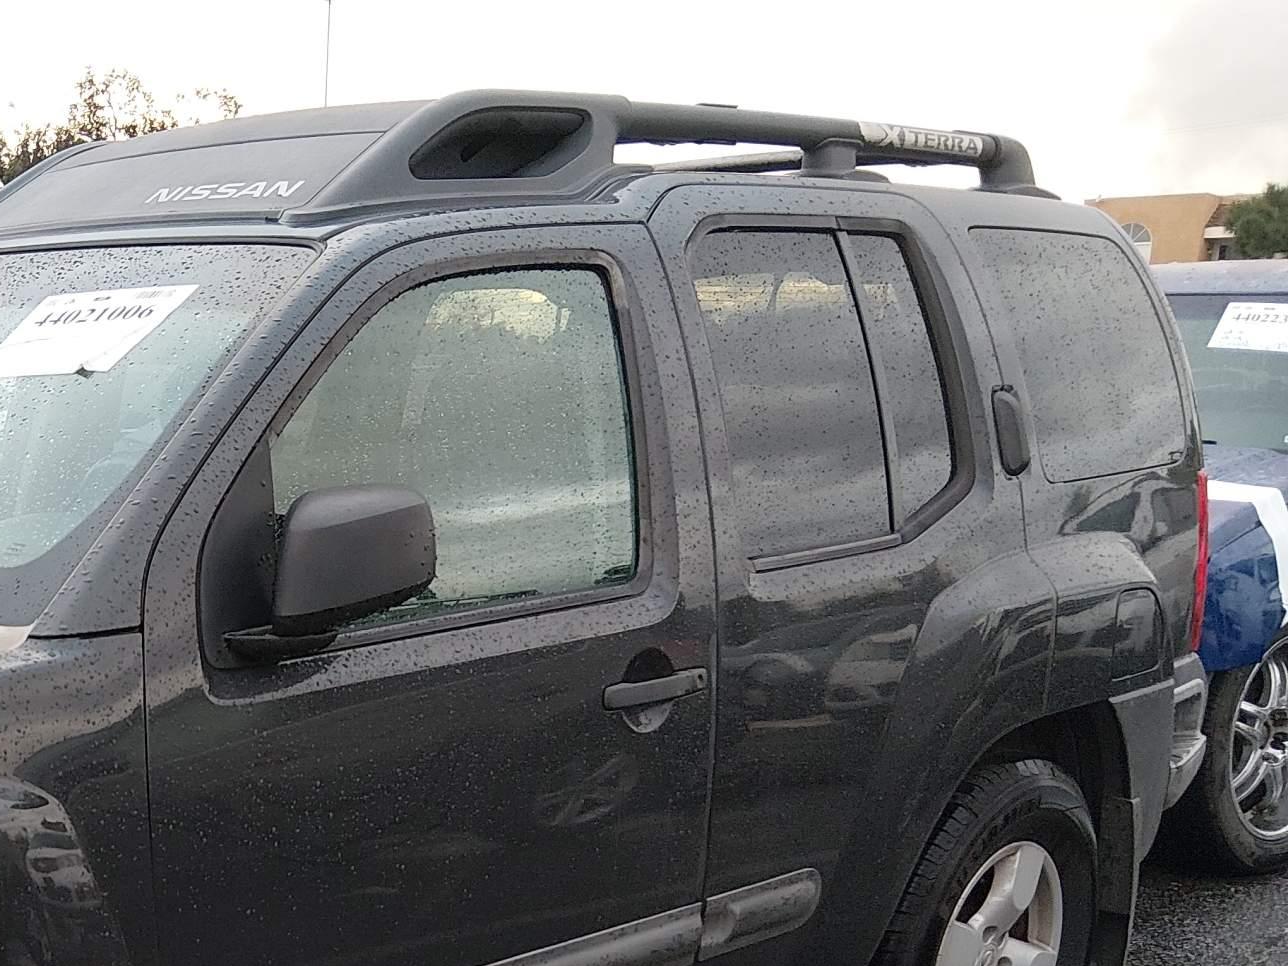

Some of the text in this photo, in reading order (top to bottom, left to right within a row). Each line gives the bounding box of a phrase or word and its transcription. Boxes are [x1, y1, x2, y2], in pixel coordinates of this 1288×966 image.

[879, 124, 979, 155] XTERRA
[145, 180, 306, 204] NISSAN
[35, 304, 156, 327] 44021006
